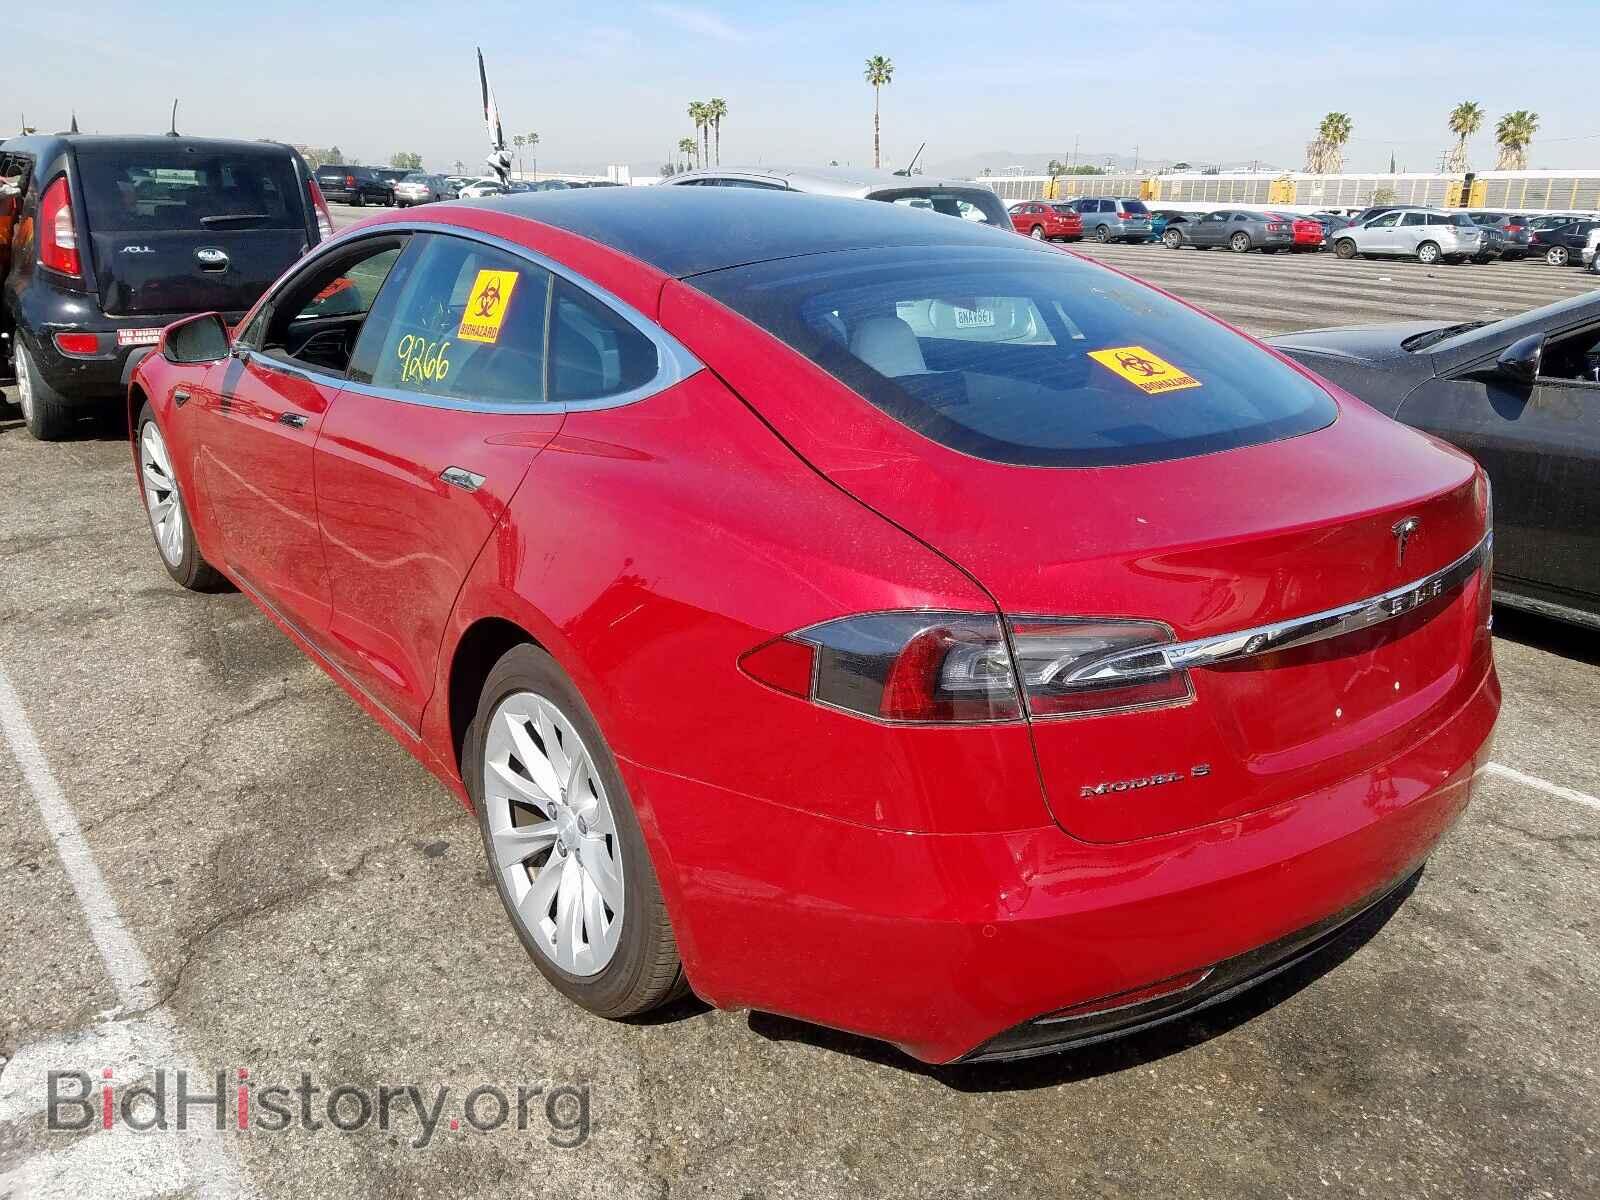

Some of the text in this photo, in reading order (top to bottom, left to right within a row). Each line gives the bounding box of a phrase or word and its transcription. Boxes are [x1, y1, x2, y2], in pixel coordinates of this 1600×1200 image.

[460, 323, 498, 339] BIOHAZARD
[398, 334, 450, 383] 9266
[1140, 376, 1197, 391] BIOHAZARD
[1080, 764, 1211, 797] MODEL S
